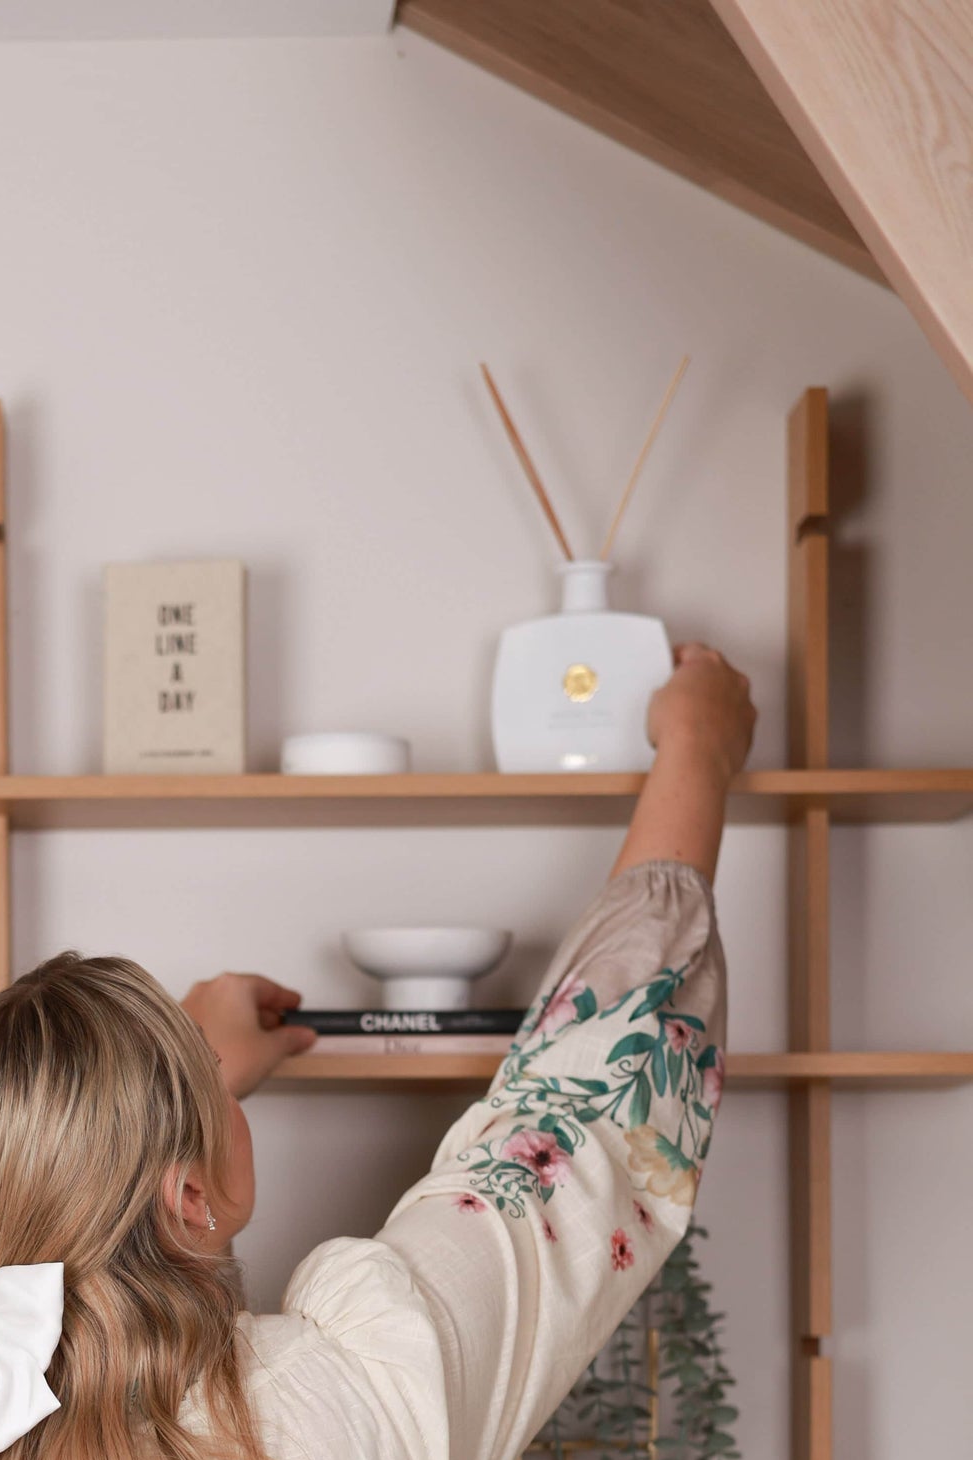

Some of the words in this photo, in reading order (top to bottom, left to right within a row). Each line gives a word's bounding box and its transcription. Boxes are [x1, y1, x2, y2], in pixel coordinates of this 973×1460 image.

[157, 604, 194, 627] ONE
[155, 632, 197, 656] LINE
[170, 661, 183, 682] A
[158, 691, 195, 713] DAY
[359, 1013, 442, 1032] CHANEL
